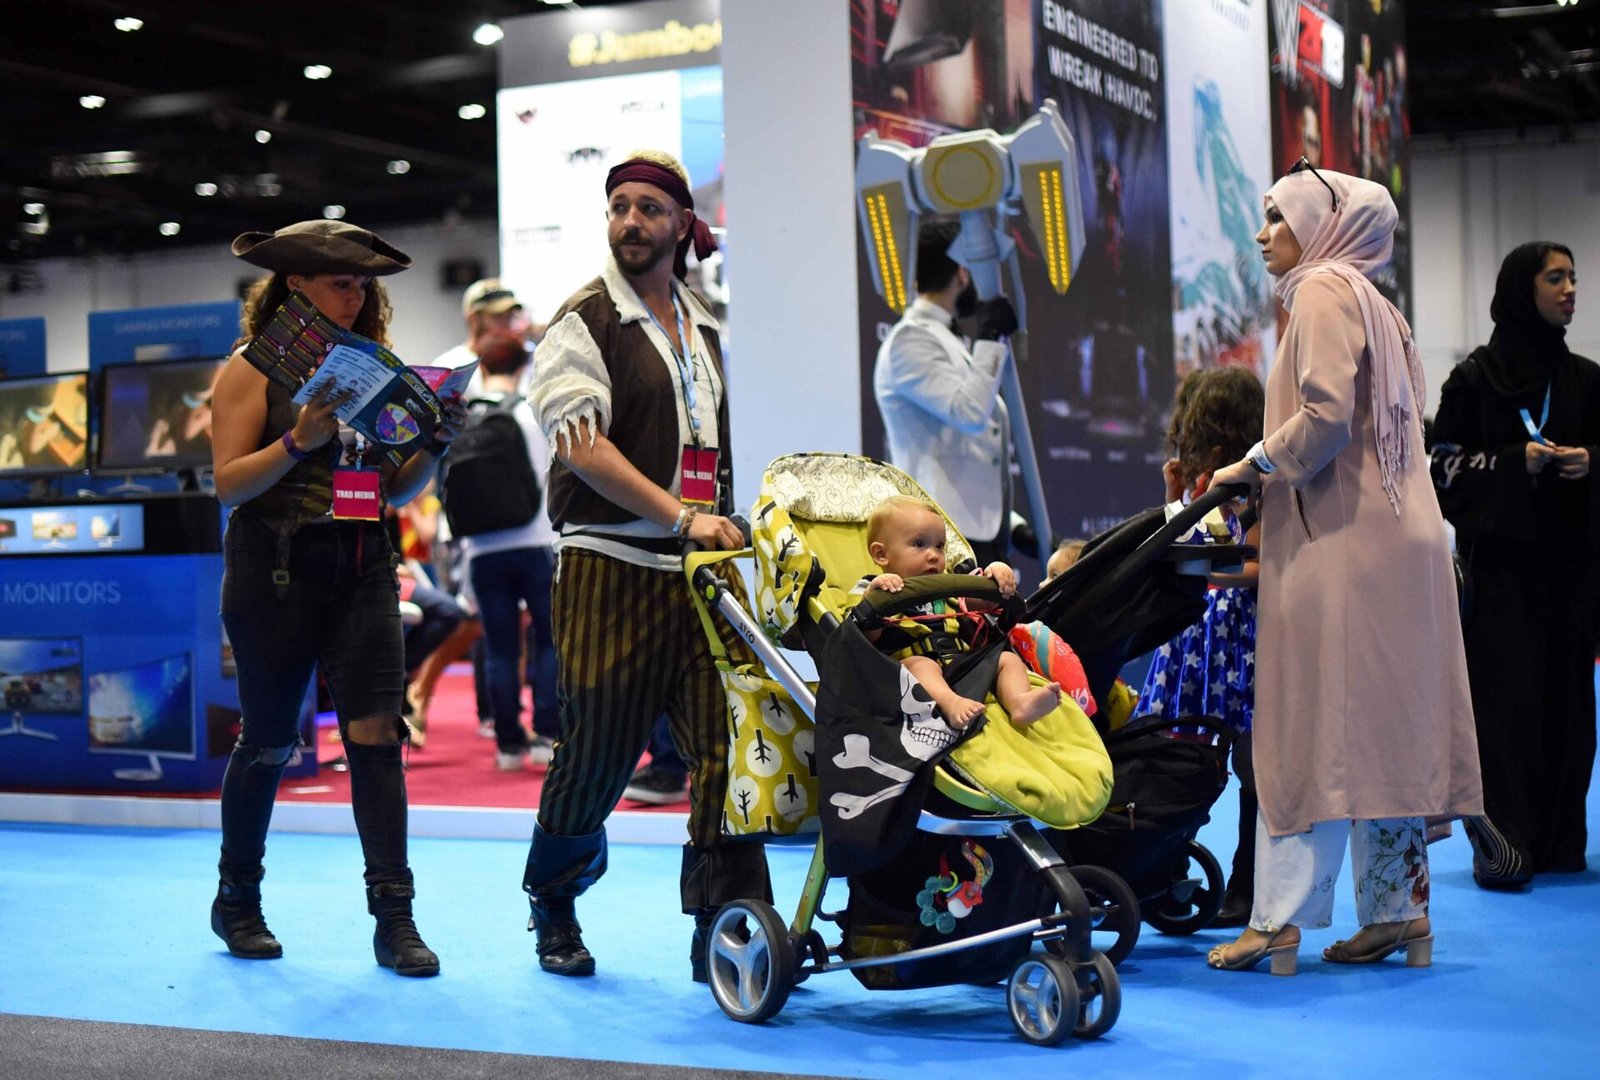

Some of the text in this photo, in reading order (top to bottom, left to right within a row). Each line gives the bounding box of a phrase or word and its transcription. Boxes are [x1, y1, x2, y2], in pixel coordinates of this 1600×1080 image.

[1042, 0, 1159, 82] ENGINEERED TO
[1047, 44, 1157, 122] WREAK HAVOC.
[113, 314, 221, 336] GAMING MONITORS
[336, 489, 376, 500] TRAD MEDIA
[4, 581, 121, 605] MONITORS
